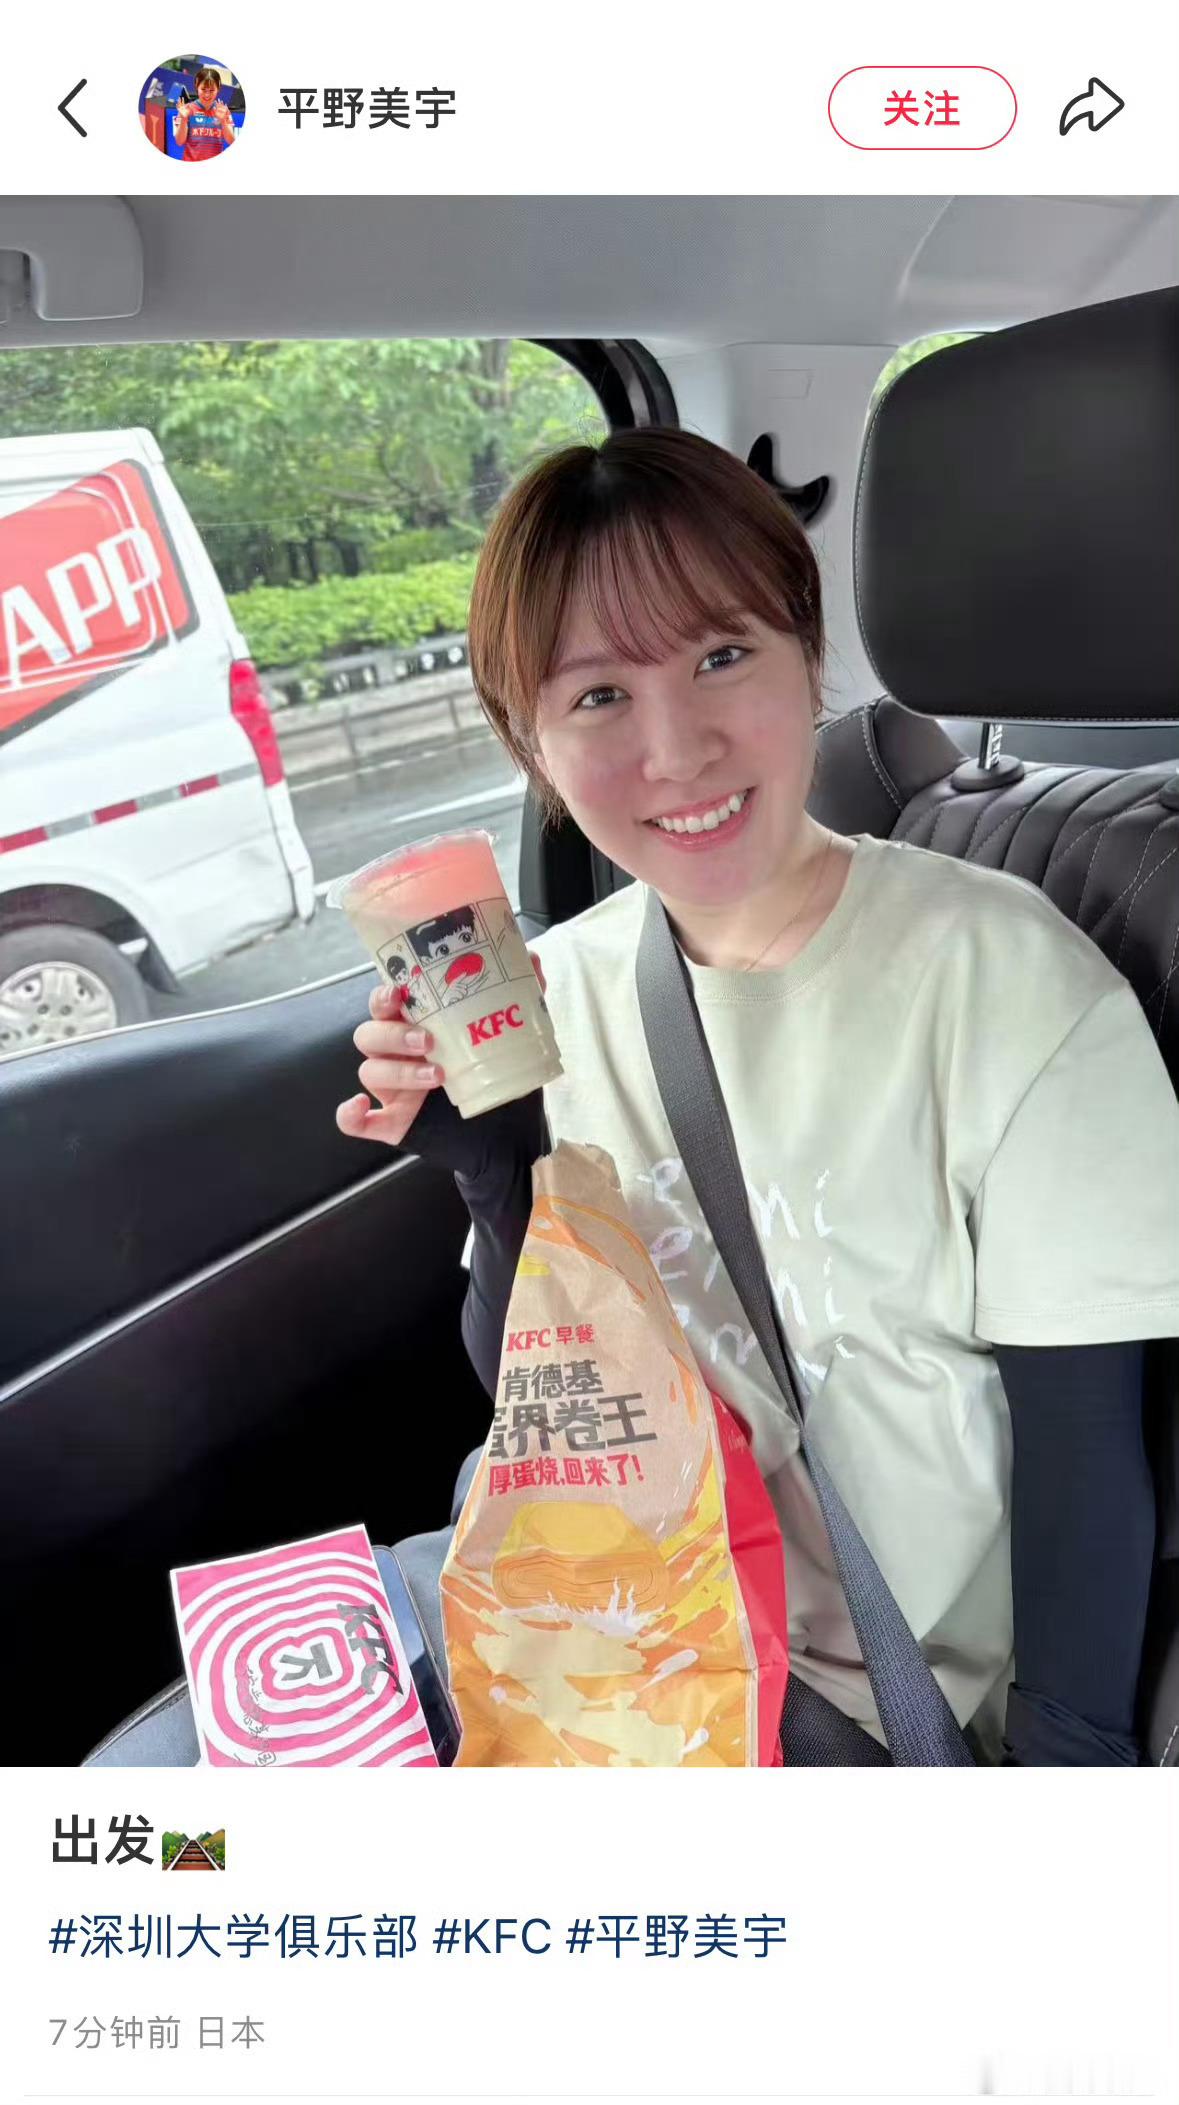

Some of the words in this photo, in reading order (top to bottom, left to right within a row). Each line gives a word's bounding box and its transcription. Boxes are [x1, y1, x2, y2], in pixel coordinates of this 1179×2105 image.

[1, 527, 162, 688] APP
[466, 1004, 524, 1046] KFC
[506, 1328, 551, 1351] KFC
[556, 1324, 595, 1344] 早餐
[502, 1359, 604, 1402] 肯德基
[337, 1603, 404, 1695] KFC
